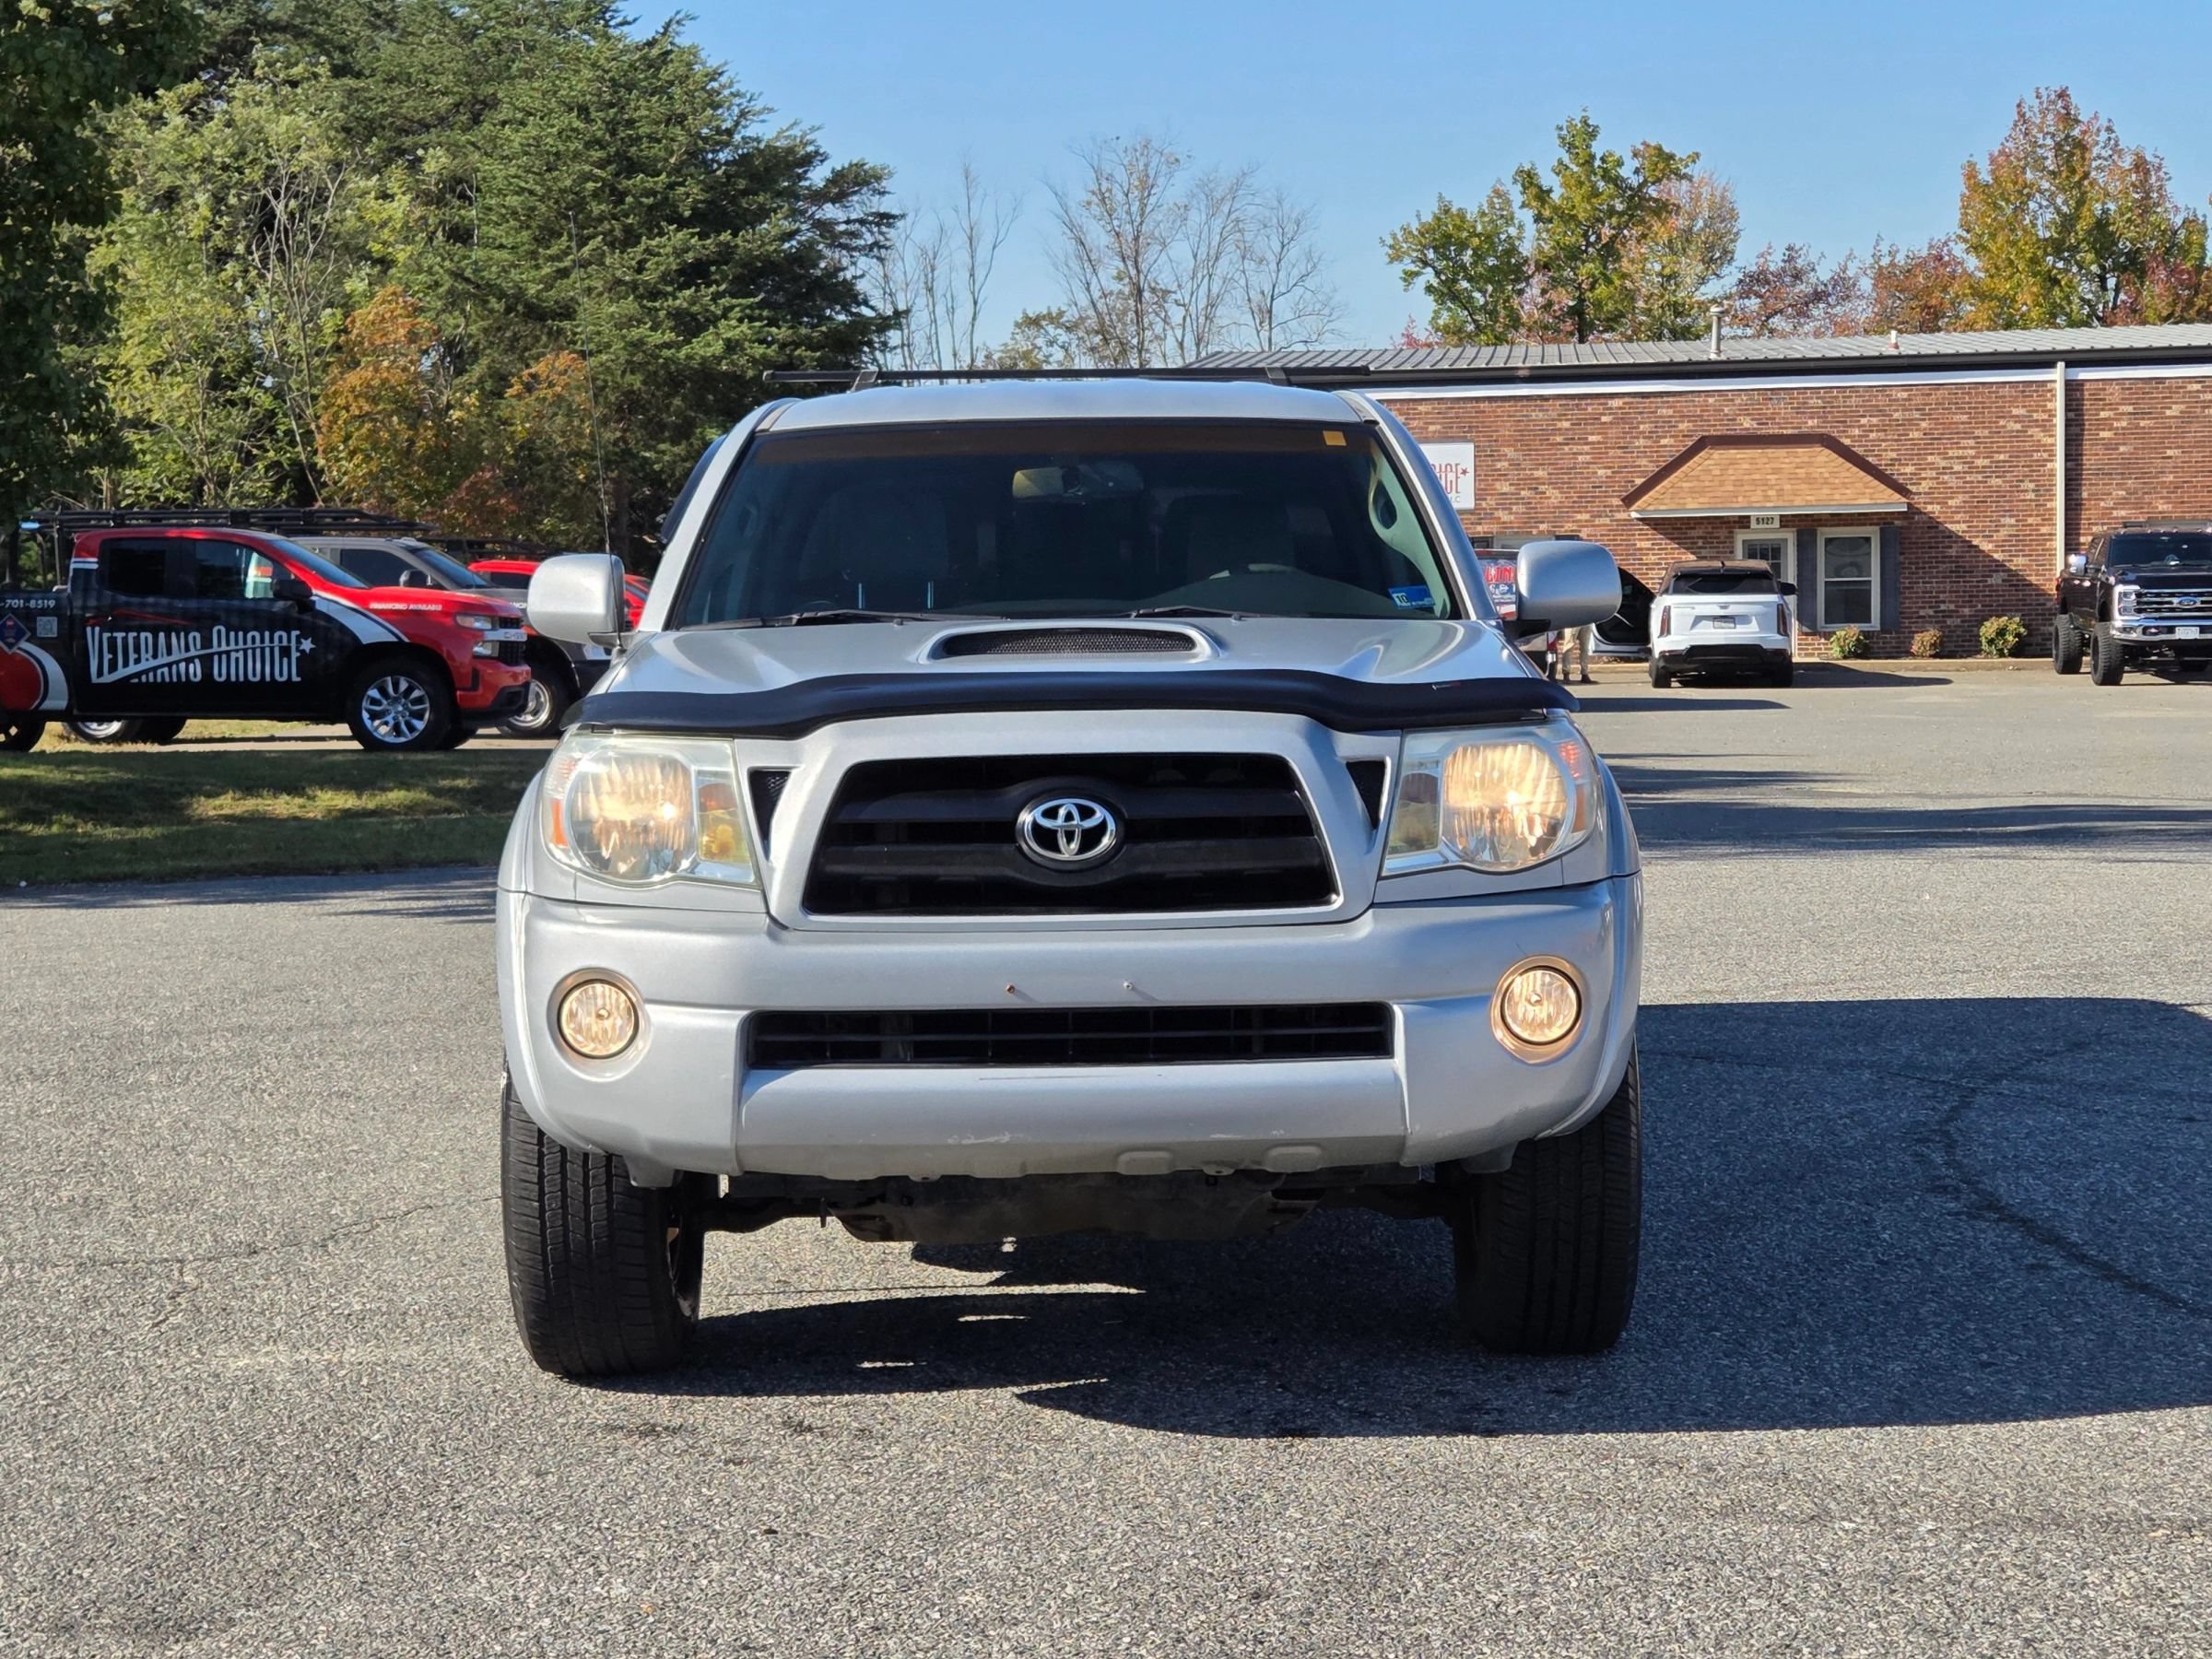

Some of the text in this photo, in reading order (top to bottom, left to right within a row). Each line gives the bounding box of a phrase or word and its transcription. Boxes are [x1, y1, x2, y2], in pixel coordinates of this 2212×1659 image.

[1755, 516, 1775, 525] 5127
[86, 625, 302, 684] VETERANS CHOICE
